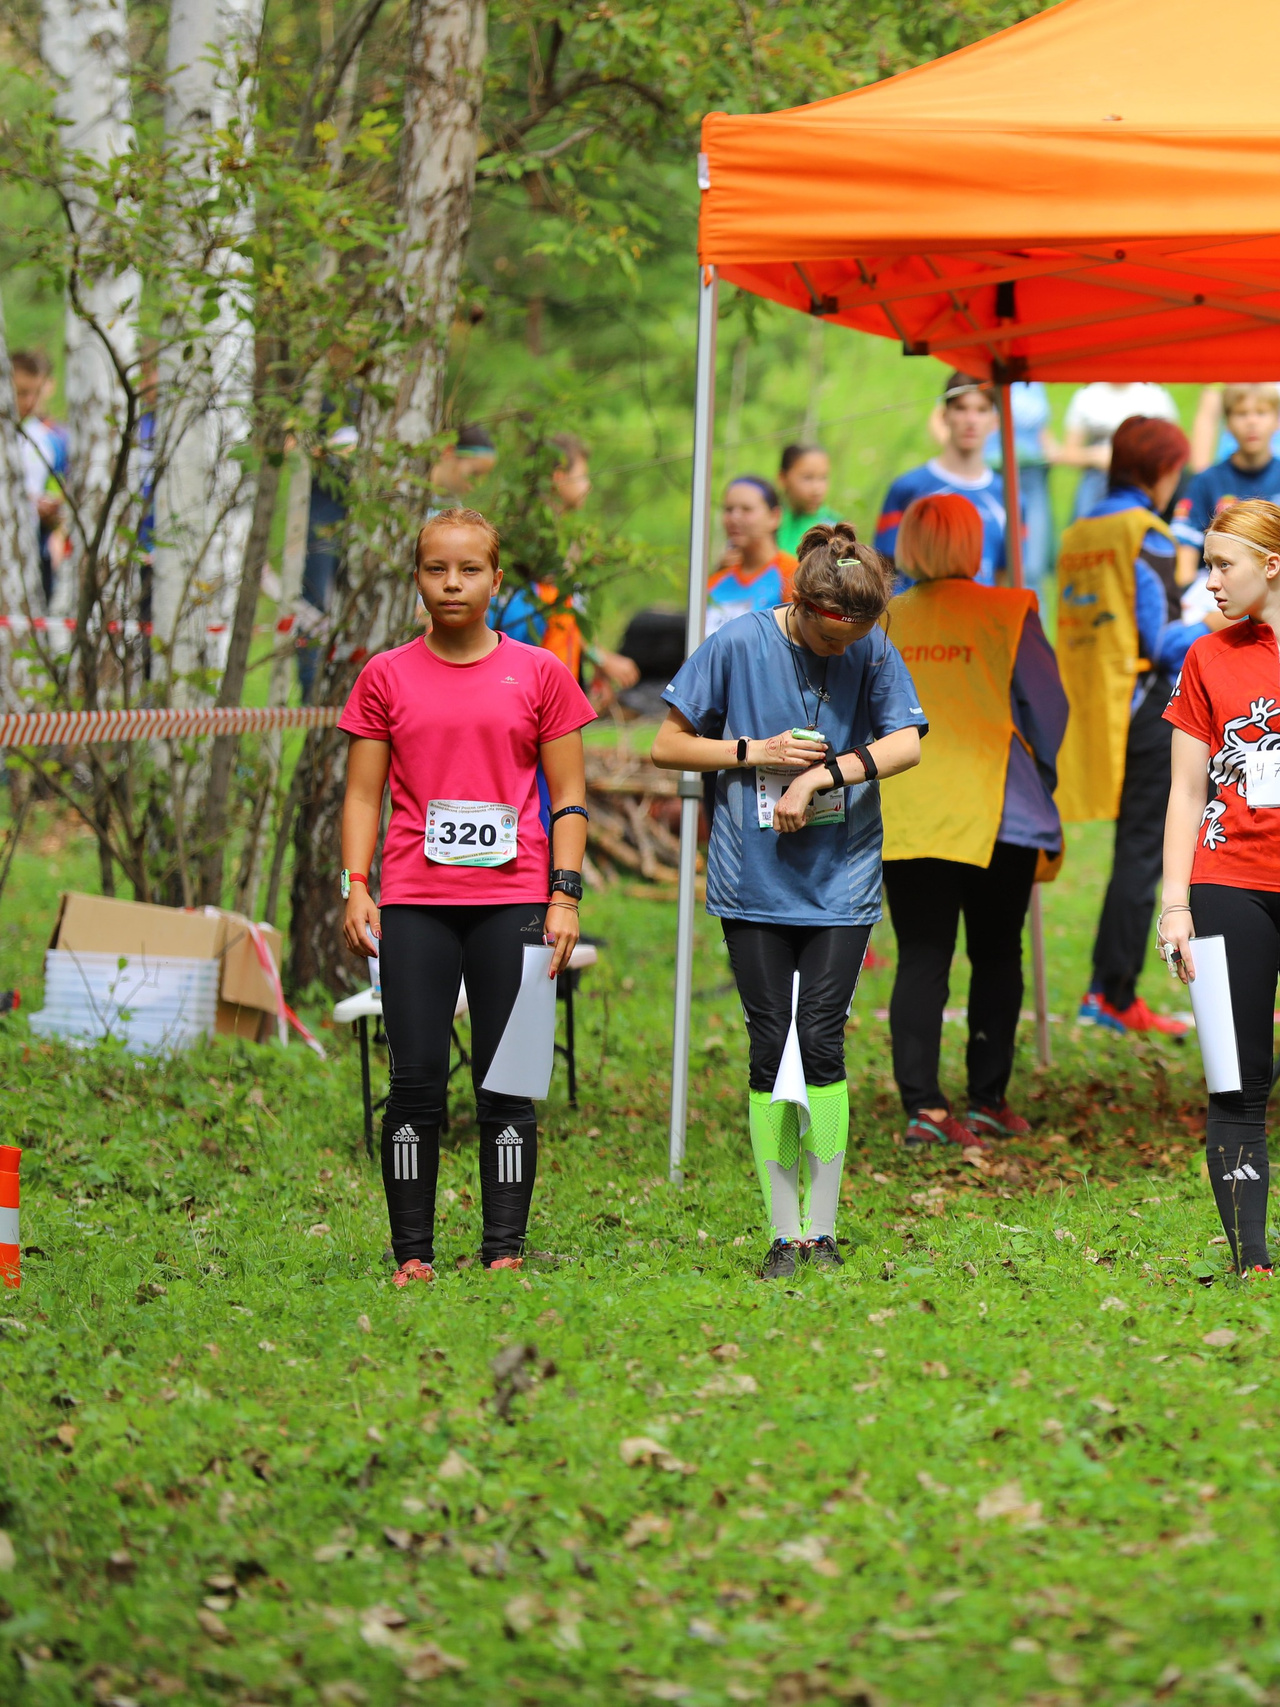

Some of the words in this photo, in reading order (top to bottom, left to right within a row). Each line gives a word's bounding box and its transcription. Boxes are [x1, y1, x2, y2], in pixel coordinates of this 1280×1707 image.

[901, 644, 974, 664] СПОРТ
[439, 821, 497, 847] 320
[392, 1134, 420, 1143] adidas
[495, 1136, 524, 1145] adidas
